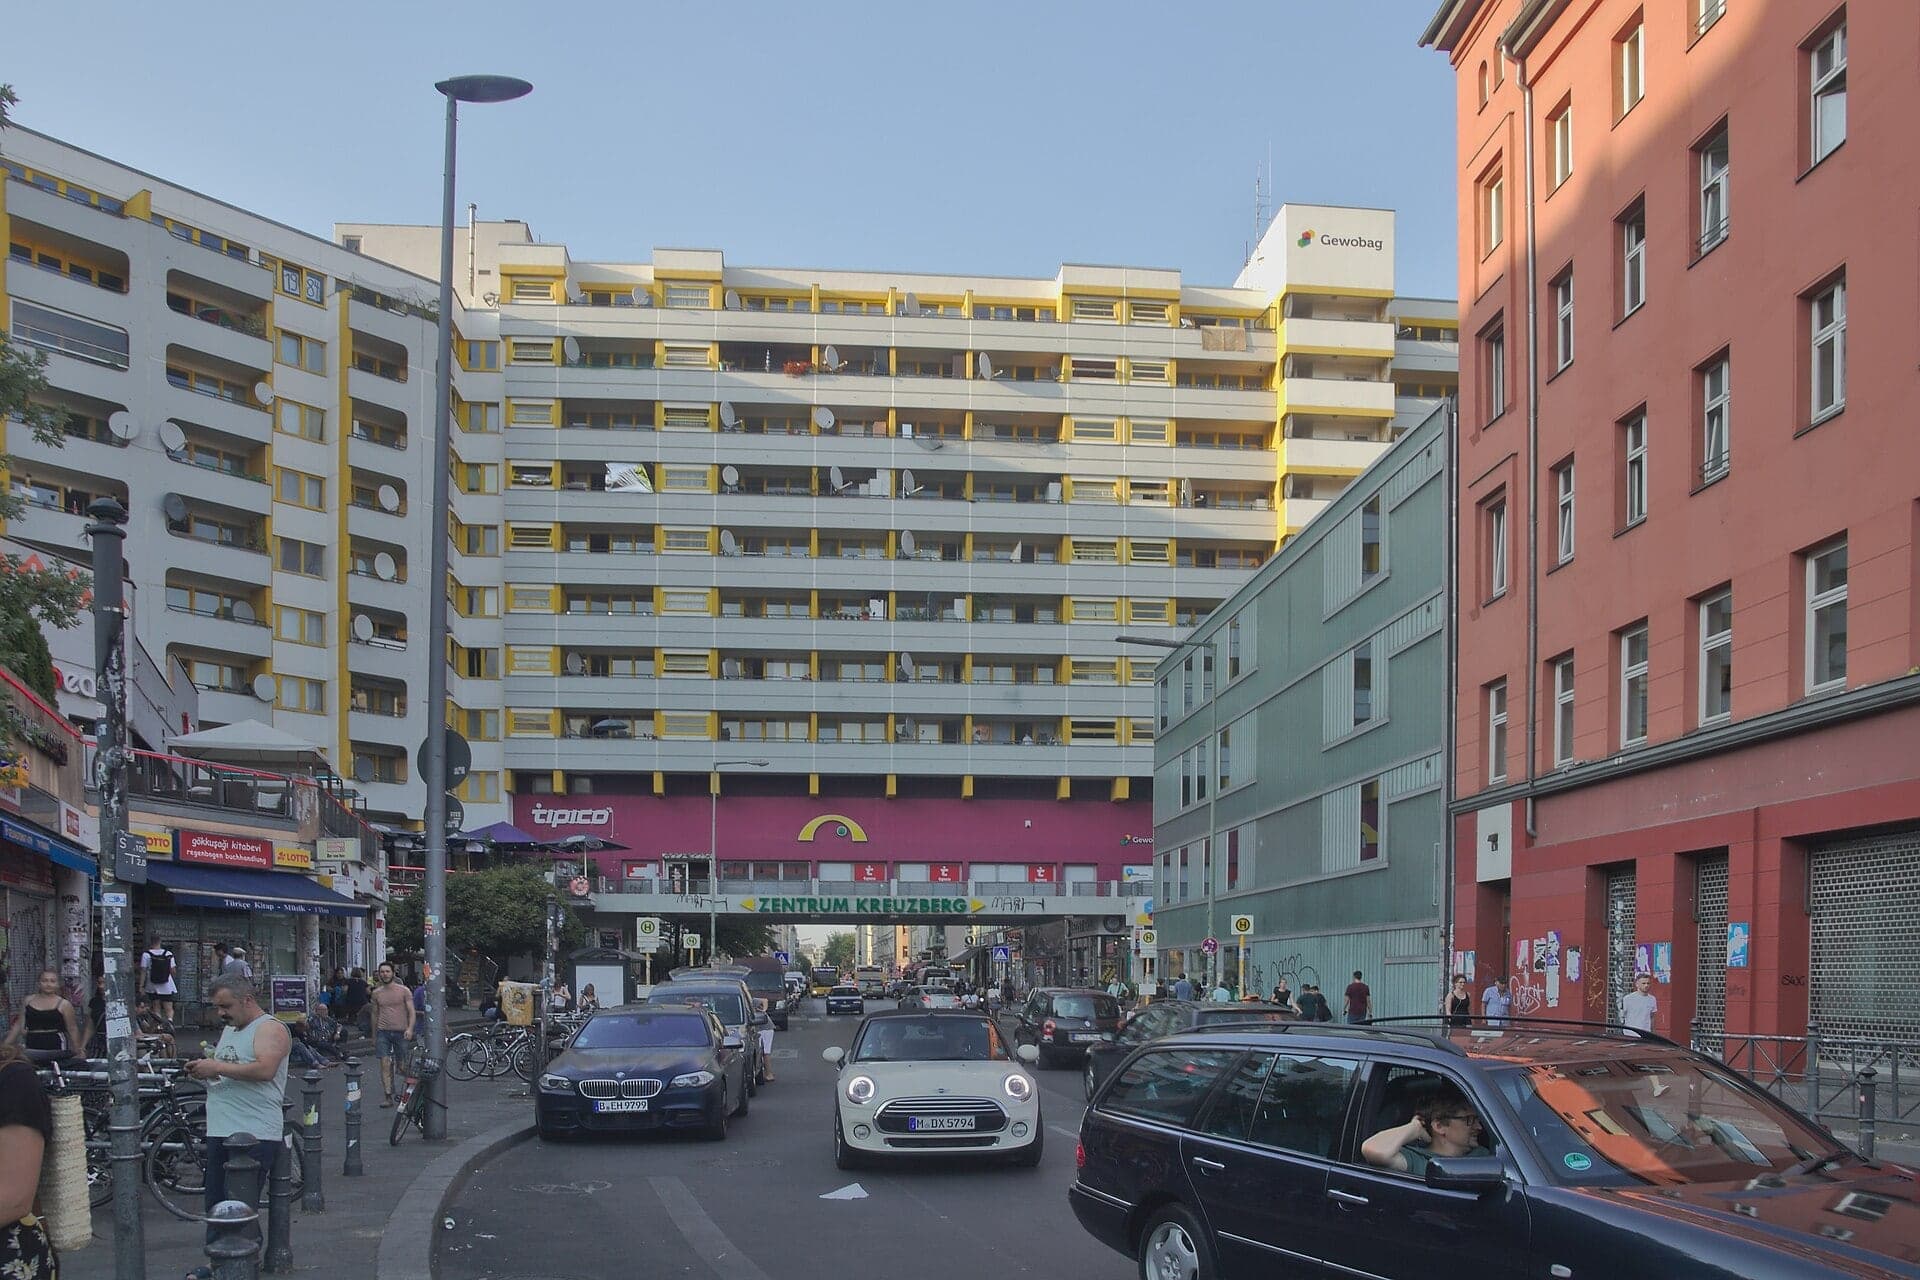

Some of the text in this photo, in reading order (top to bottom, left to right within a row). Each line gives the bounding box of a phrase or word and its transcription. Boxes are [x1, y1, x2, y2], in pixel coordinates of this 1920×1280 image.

[1320, 234, 1383, 251] Gewobag
[285, 272, 320, 299] 19 84
[531, 802, 609, 828] tipico
[119, 837, 127, 849] S
[146, 836, 170, 848] OTTO
[191, 836, 261, 852] gökkuşağı kitabevi
[1132, 836, 1154, 844] Gewo
[186, 849, 267, 865] regenbogen buchhandlung
[286, 853, 309, 864] LOTTO
[223, 899, 251, 909] Türkçe
[254, 901, 275, 911] Kitap
[758, 897, 968, 913] ZENTRUM KREUZBERG
[610, 1101, 623, 1110] EH
[916, 1118, 974, 1129] M DX 5794
